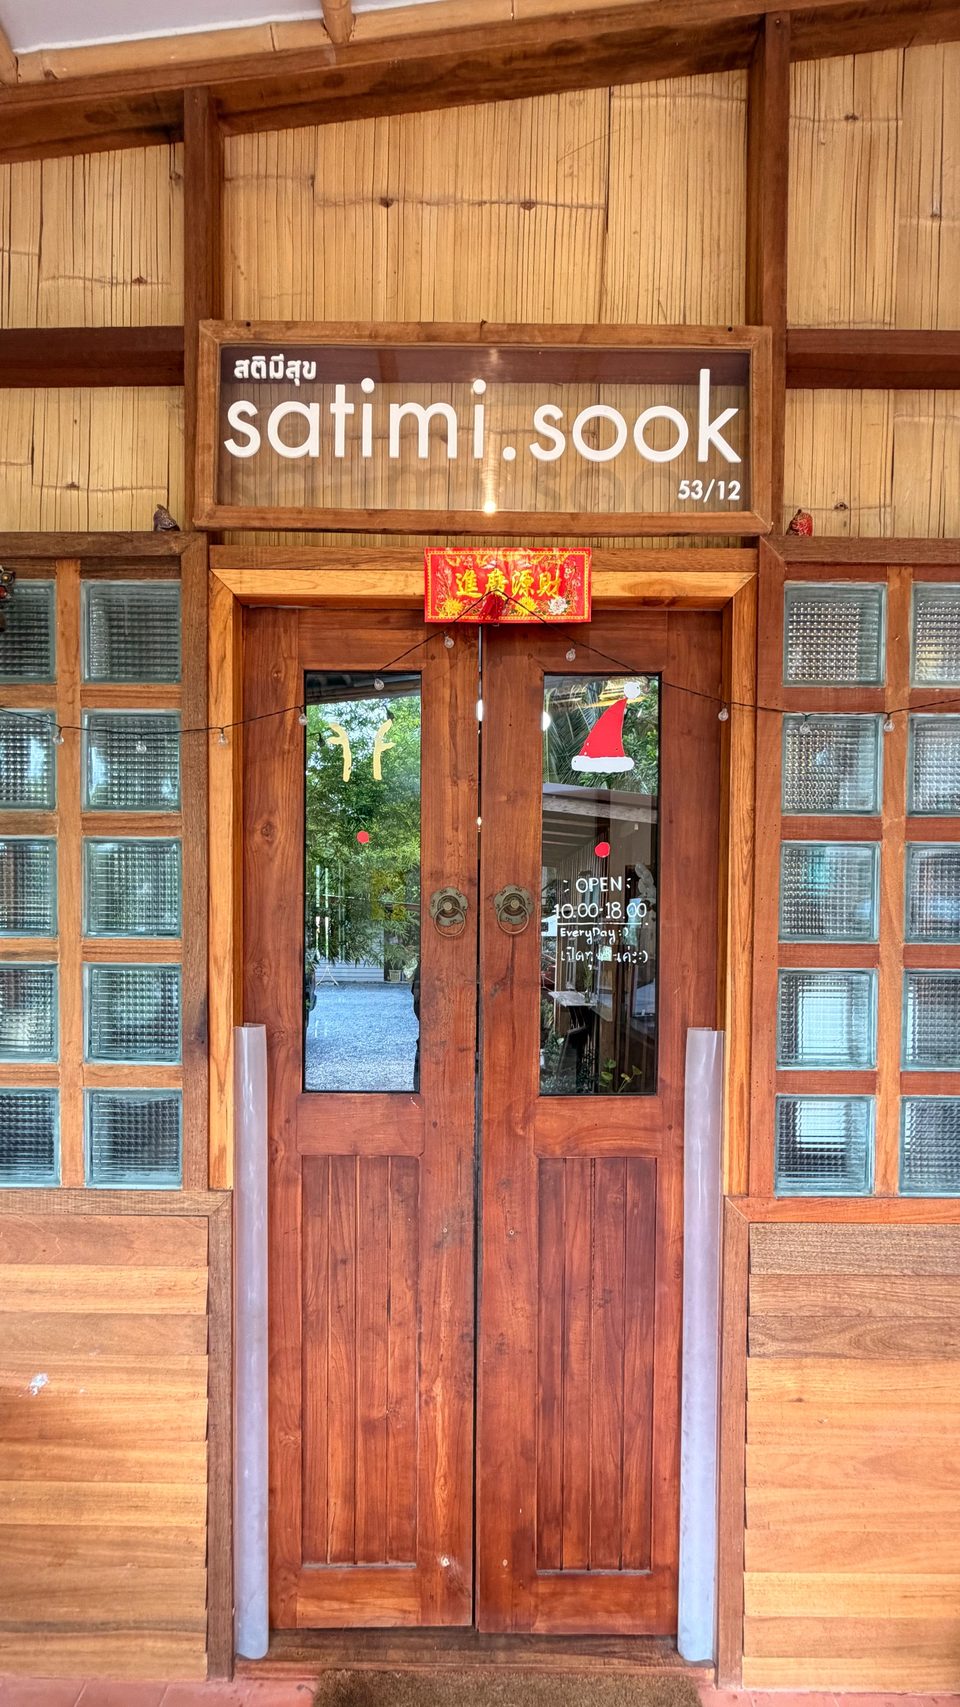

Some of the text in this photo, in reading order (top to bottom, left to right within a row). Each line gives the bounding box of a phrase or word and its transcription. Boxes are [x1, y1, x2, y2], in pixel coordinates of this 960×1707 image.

[234, 353, 317, 387] สติมีสุข
[223, 368, 742, 463] satimi.sook
[677, 479, 742, 502] 53/12
[576, 876, 622, 893] OPEN
